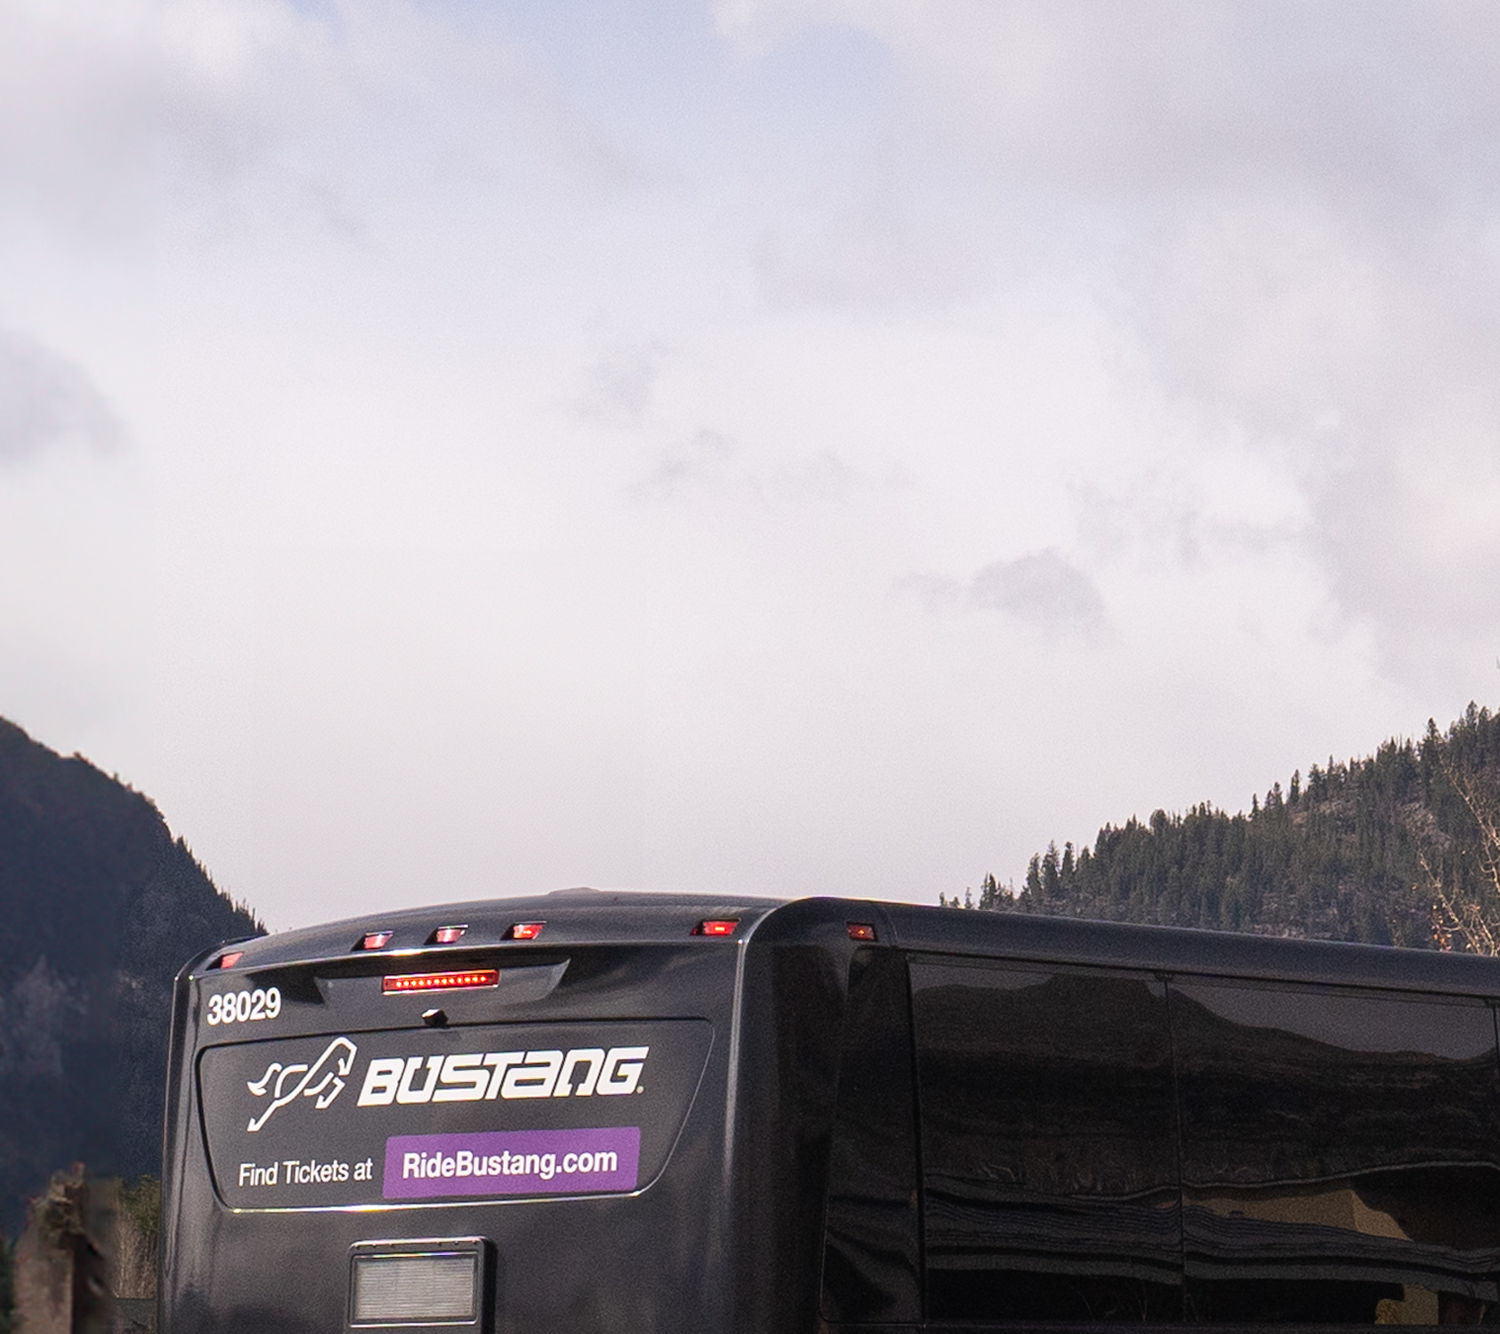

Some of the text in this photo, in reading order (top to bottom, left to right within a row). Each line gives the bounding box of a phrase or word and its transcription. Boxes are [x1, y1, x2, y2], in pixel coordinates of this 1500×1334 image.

[207, 988, 282, 1025] 38029
[238, 1161, 373, 1187] Find Tickets at
[401, 1149, 619, 1183] RideBustang.com
